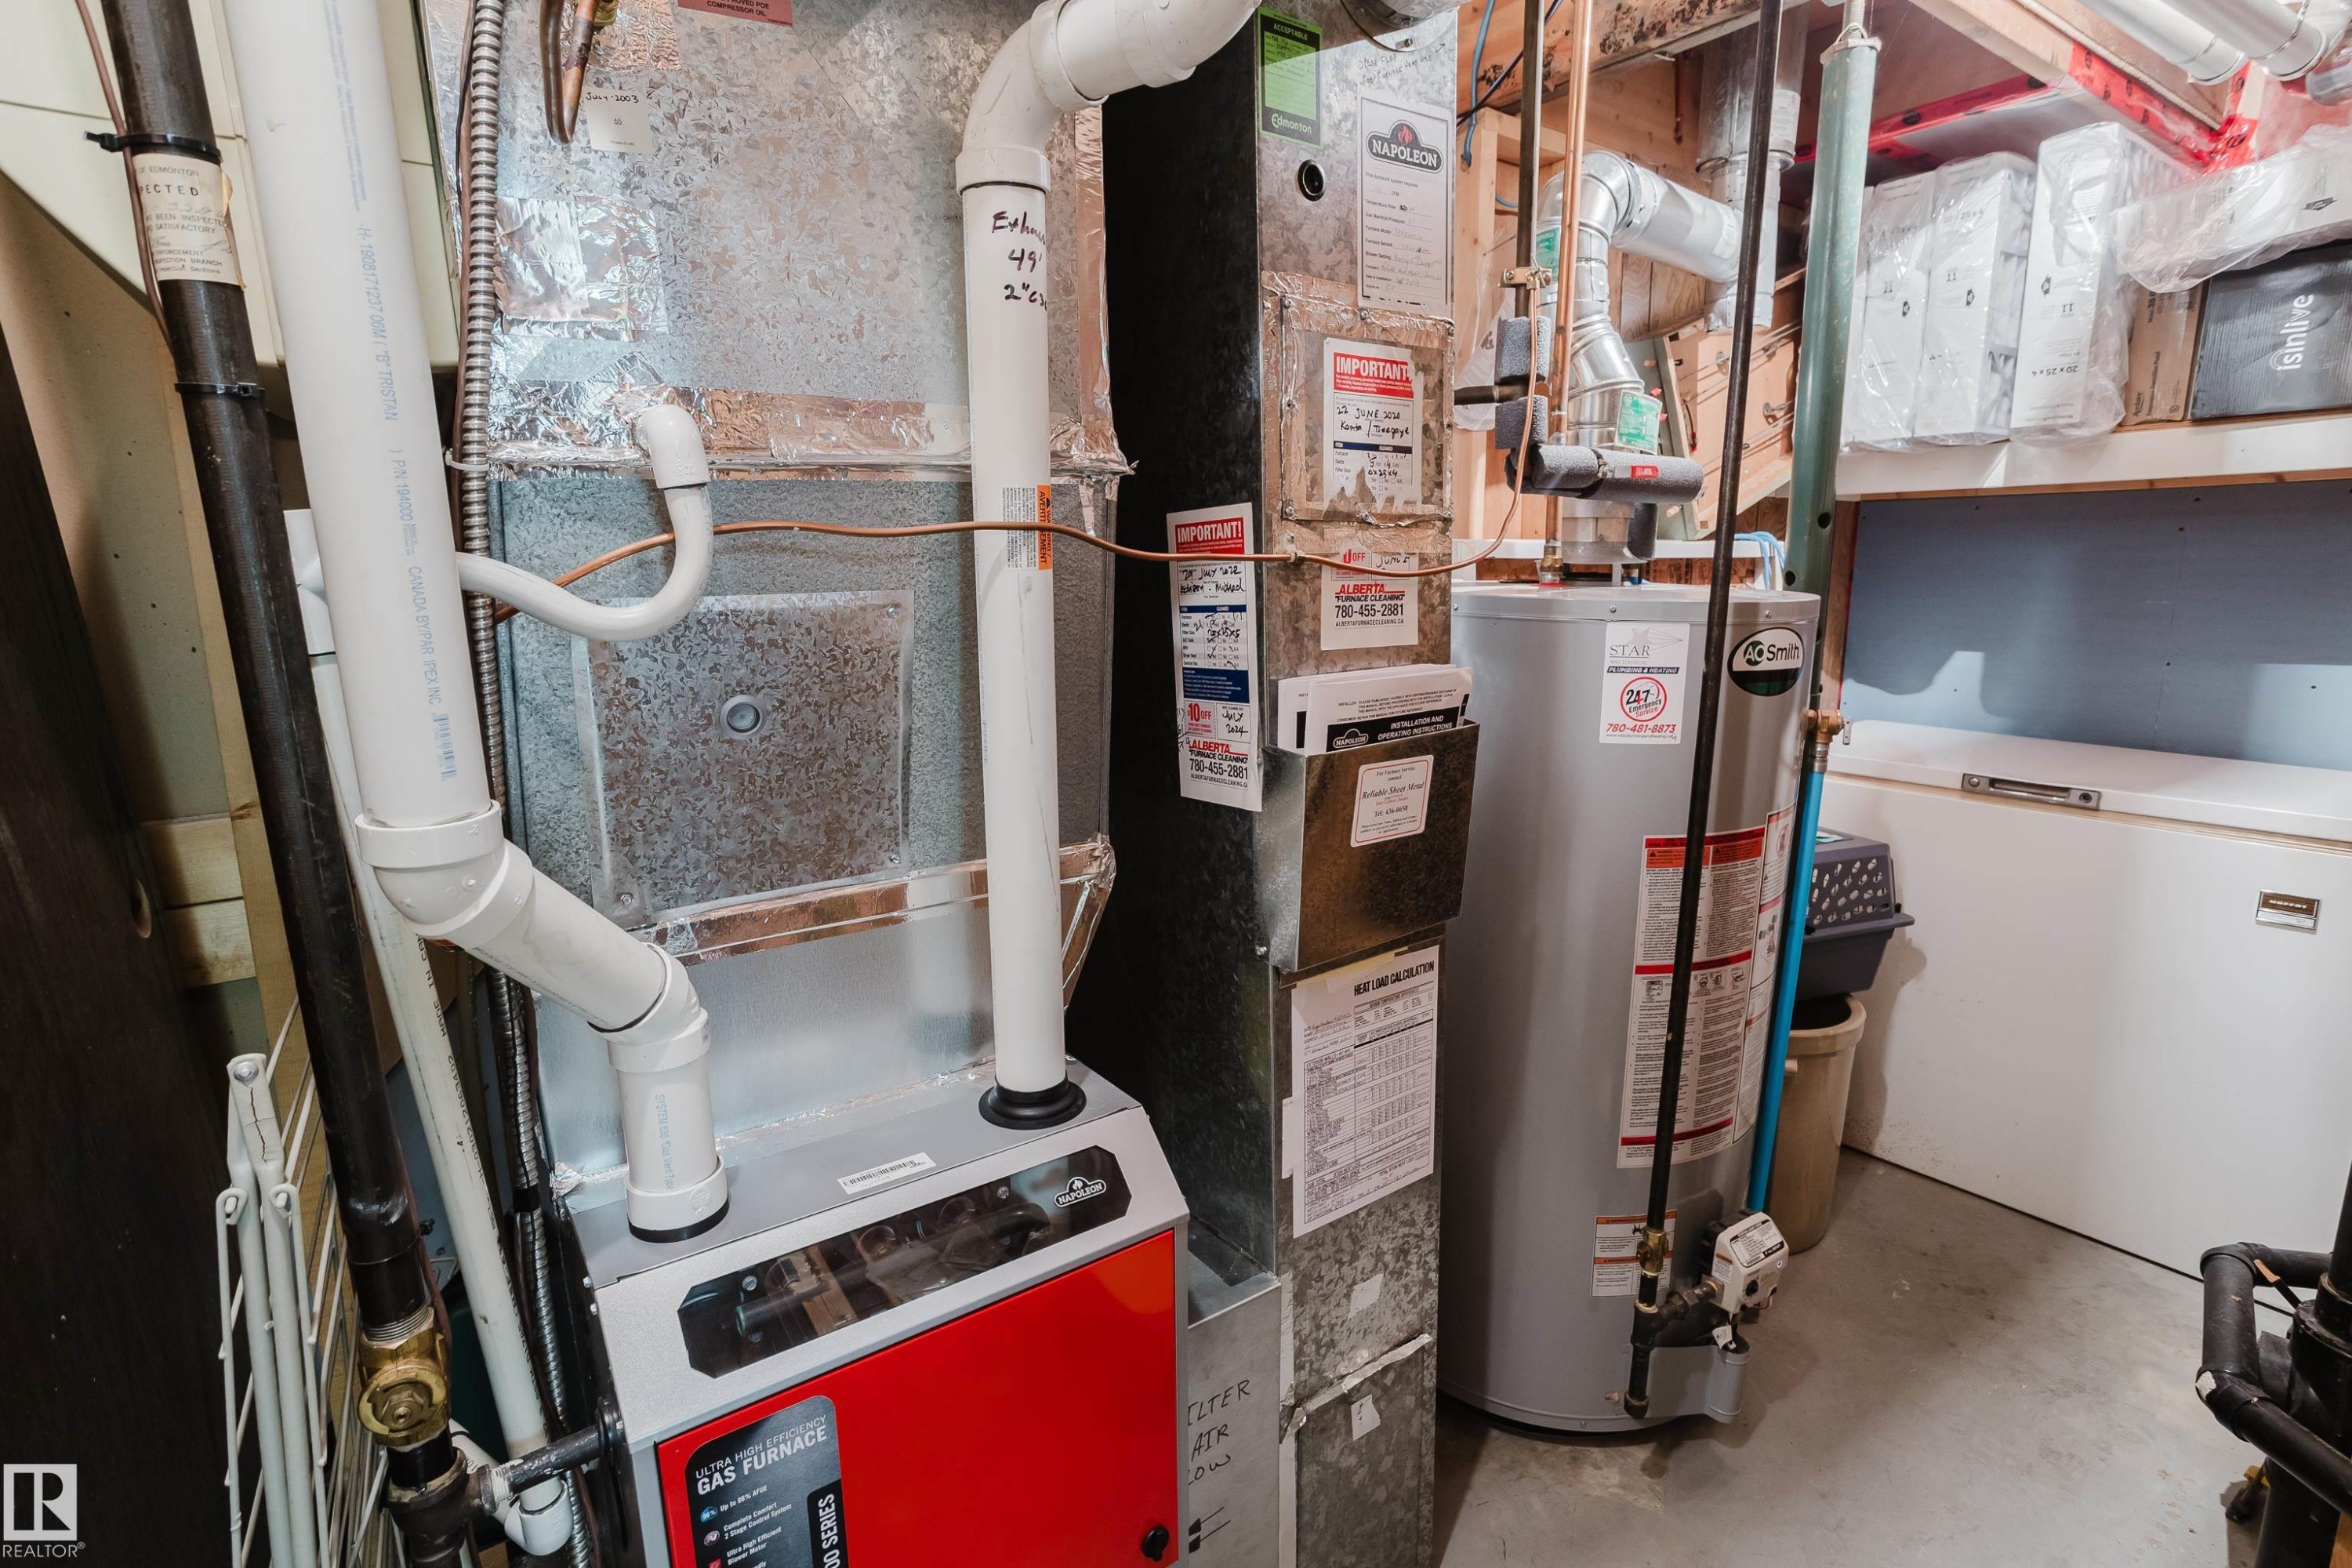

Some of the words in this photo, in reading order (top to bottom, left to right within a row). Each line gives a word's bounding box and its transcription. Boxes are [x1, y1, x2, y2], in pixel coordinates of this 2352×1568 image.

[707, 2, 754, 14] COMPRESSOR
[1273, 23, 1308, 40] ACCEPTABLE
[1272, 114, 1312, 136] Edmonton
[1372, 140, 1437, 168] NAPOLEON
[149, 167, 199, 177] EDMONTON
[157, 223, 216, 234] SATISFACTORY
[191, 258, 222, 267] BRANCH
[2274, 293, 2314, 372] isinlive
[1337, 406, 1348, 415] 22
[1354, 408, 1379, 419] JUNE
[1383, 411, 1402, 420] 2020
[1178, 521, 1242, 543] IMPORTANT!
[1352, 553, 1366, 561] OFF
[408, 566, 426, 613] CANADA
[1339, 583, 1385, 594] ALBERTA
[1335, 604, 1403, 618] 780-455-2881
[416, 615, 434, 655] BY/PAR
[1610, 644, 1650, 656] STAR
[424, 660, 438, 684] IPEX
[1201, 710, 1211, 720] OFF
[1629, 699, 1662, 713] Emergency
[1635, 706, 1658, 717] Service
[1377, 729, 1411, 741] OPERATING
[1412, 723, 1452, 735] INSTRUCTIONS
[1391, 717, 1430, 729] INSTALLATION
[1606, 724, 1676, 733] 780-481-8873
[1190, 739, 1232, 753] ALBERTA
[1336, 736, 1366, 746] NAPOLEON
[1189, 750, 1216, 760] FURNACE
[1218, 753, 1248, 764] CLEANING
[1190, 758, 1248, 779] 780-455-2881
[1362, 789, 1388, 799] Reliable
[1388, 786, 1406, 794] Sheet
[1407, 781, 1425, 791] Metal
[1354, 983, 1371, 996] HEAT
[1372, 977, 1389, 990] LOAD
[1390, 960, 1434, 984] CALCULATION
[655, 1094, 668, 1125] SYSTEM
[1058, 1182, 1103, 1205] NAPOLEON
[695, 1457, 731, 1479] ULTRA
[735, 1443, 763, 1462] HIGH
[766, 1414, 826, 1448] EFFICIENCY
[1191, 1424, 1229, 1462] AIR
[697, 1466, 736, 1495] GAS
[742, 1425, 827, 1475] FURNACE
[753, 1485, 768, 1497] AFUE
[724, 1513, 752, 1532] Complete
[753, 1502, 777, 1519] Comfort
[730, 1525, 747, 1537] Stage
[749, 1515, 770, 1528] Control
[771, 1504, 792, 1519] System
[818, 1494, 838, 1549] SERIES
[727, 1544, 742, 1558] Ultra
[743, 1538, 757, 1551] High
[757, 1526, 782, 1542] Efficient
[728, 1552, 749, 1566] Blower
[750, 1542, 768, 1555] Motor
